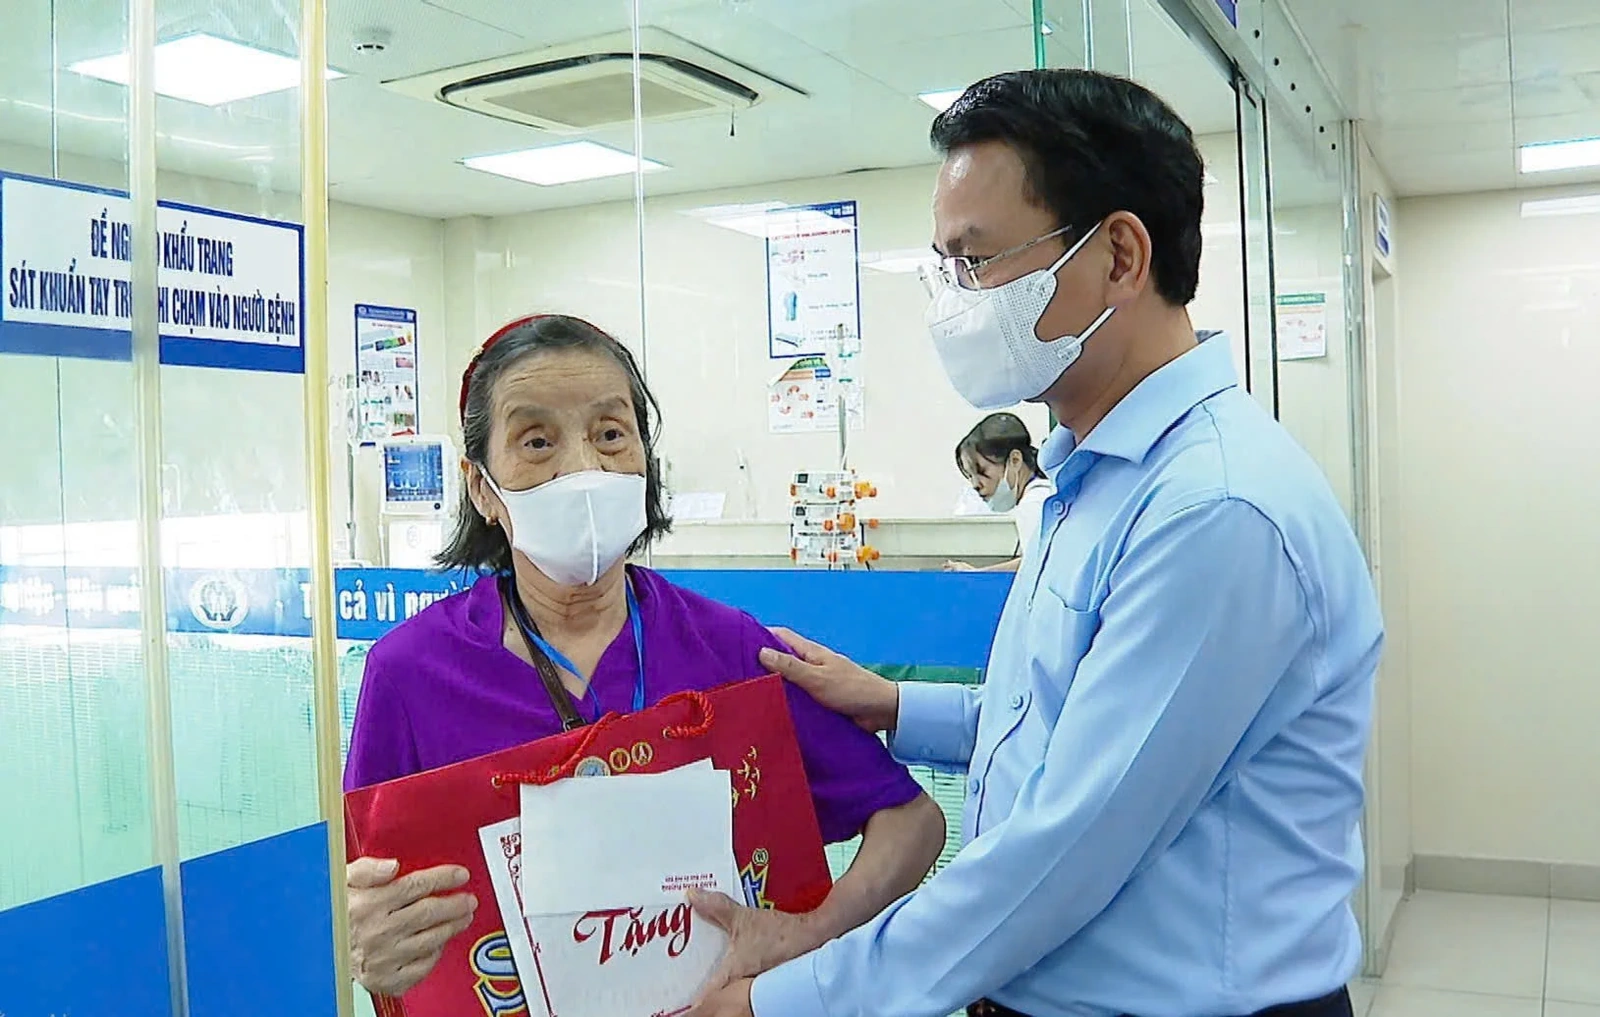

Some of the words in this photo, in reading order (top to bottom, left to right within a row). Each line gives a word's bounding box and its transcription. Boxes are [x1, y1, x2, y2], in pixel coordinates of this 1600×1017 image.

[163, 220, 194, 272] KHẨU
[197, 237, 233, 277] TRANG
[9, 260, 36, 309] SÁT
[39, 258, 86, 314] KHUẨN
[89, 276, 110, 316] TAY
[158, 286, 169, 324] HI
[172, 288, 206, 334] CHẠM
[208, 285, 230, 330] VÀO
[233, 289, 266, 333] NGƯỜI
[268, 293, 296, 342] BỆNH
[338, 578, 368, 621] cả
[374, 582, 396, 622] vì
[573, 902, 693, 965] Tặng
